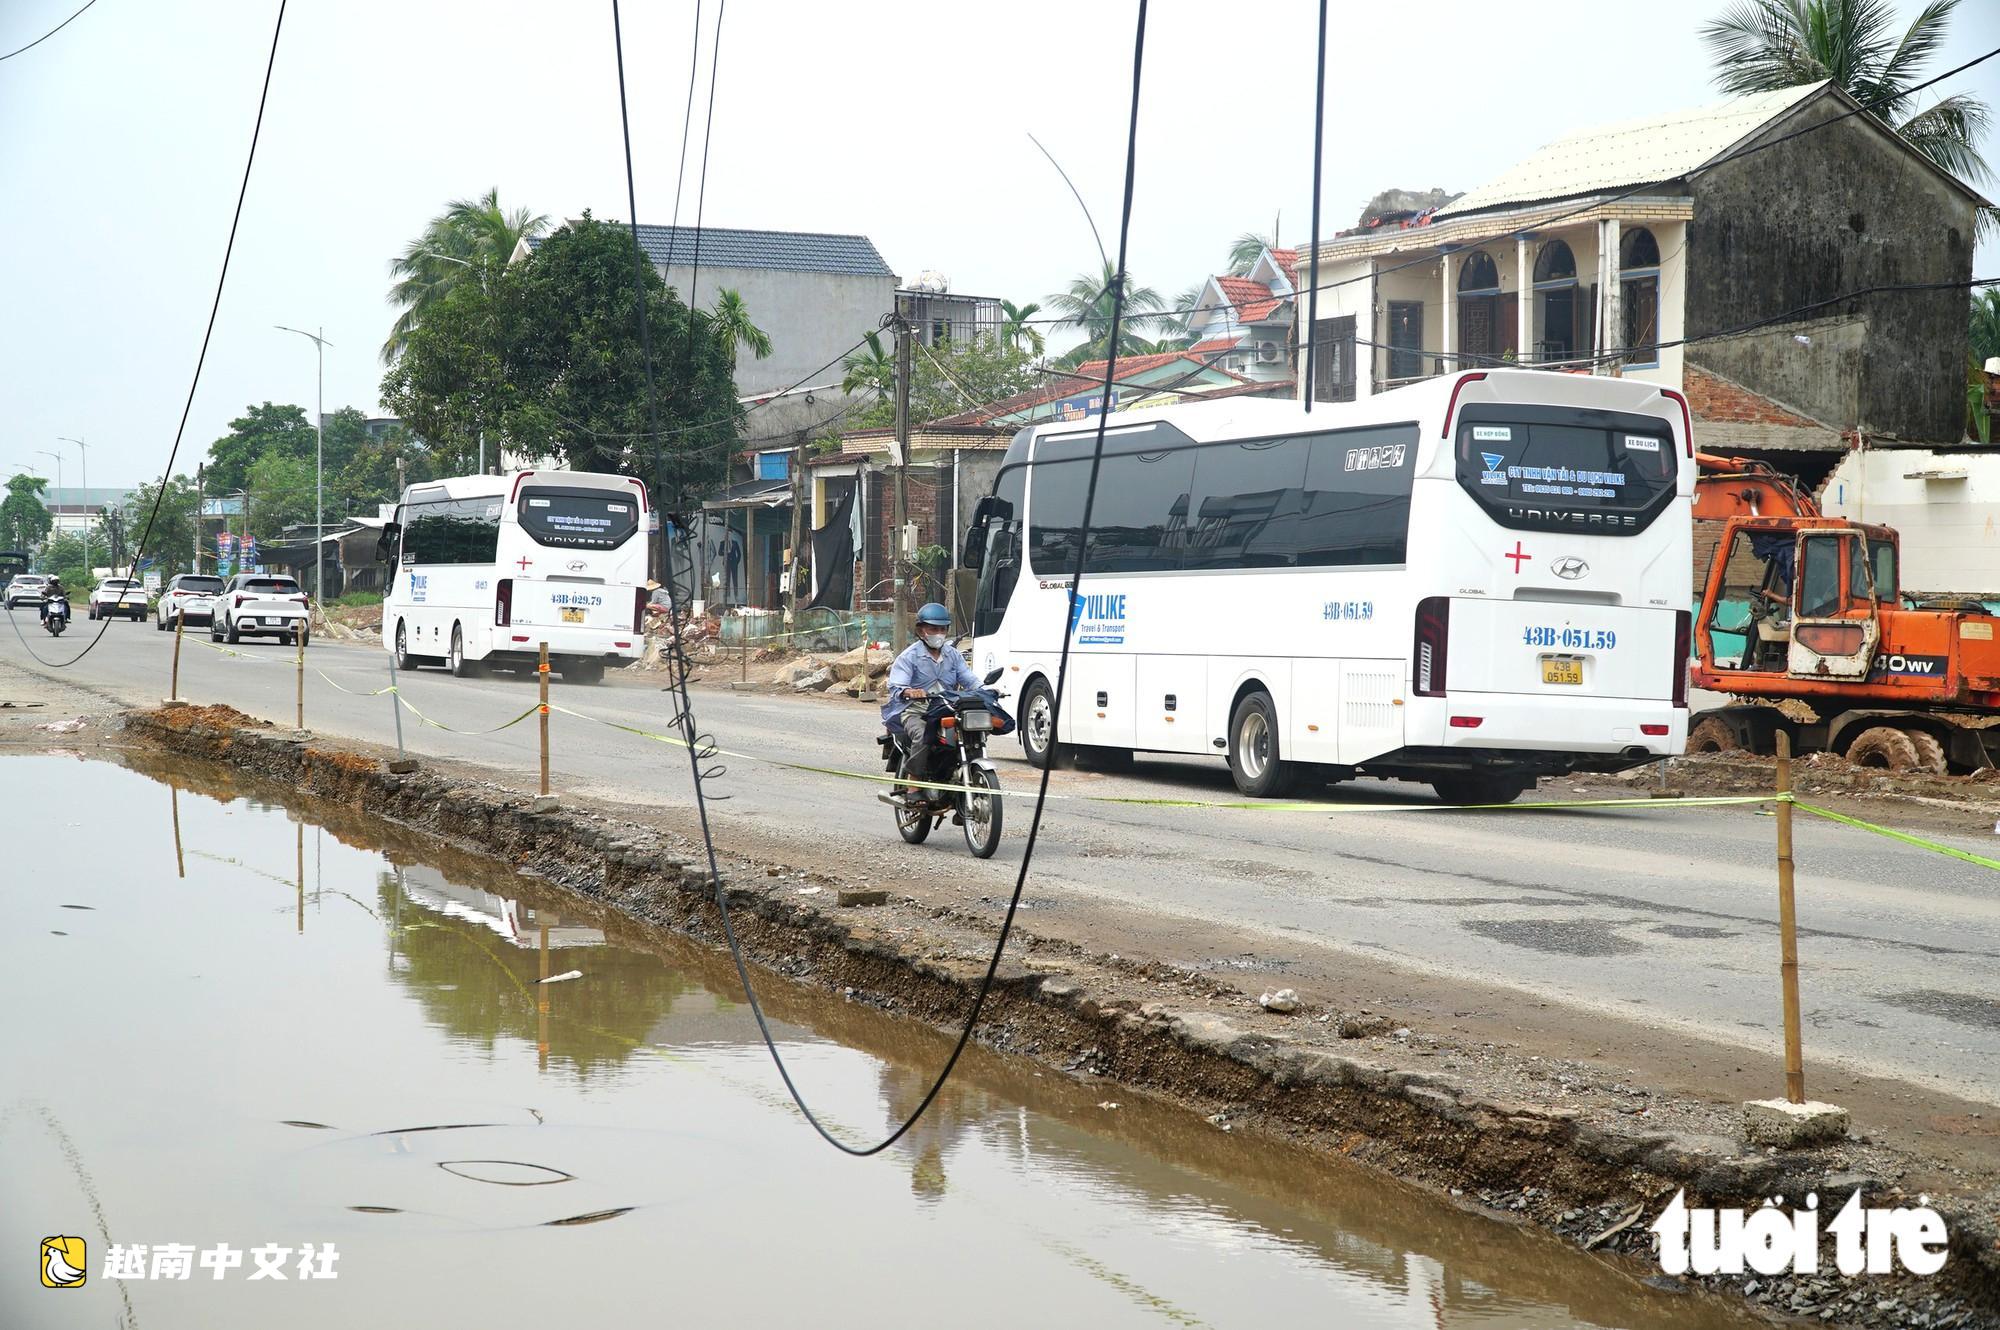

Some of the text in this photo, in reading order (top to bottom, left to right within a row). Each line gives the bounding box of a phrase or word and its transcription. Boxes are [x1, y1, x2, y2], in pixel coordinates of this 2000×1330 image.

[1627, 438, 1635, 446] XE
[1636, 439, 1644, 447] DU
[1482, 471, 1506, 479] VILIKE
[1523, 467, 1542, 480] TNHH
[1569, 469, 1576, 481] &
[1604, 472, 1625, 486] VILIKE
[1508, 508, 1636, 526] UNIVERSE
[1088, 594, 1126, 620] VILIKE
[1081, 624, 1096, 632] Travel
[1102, 624, 1125, 634] Transport
[1553, 662, 1571, 672] 43B
[1547, 672, 1578, 683] 051.59
